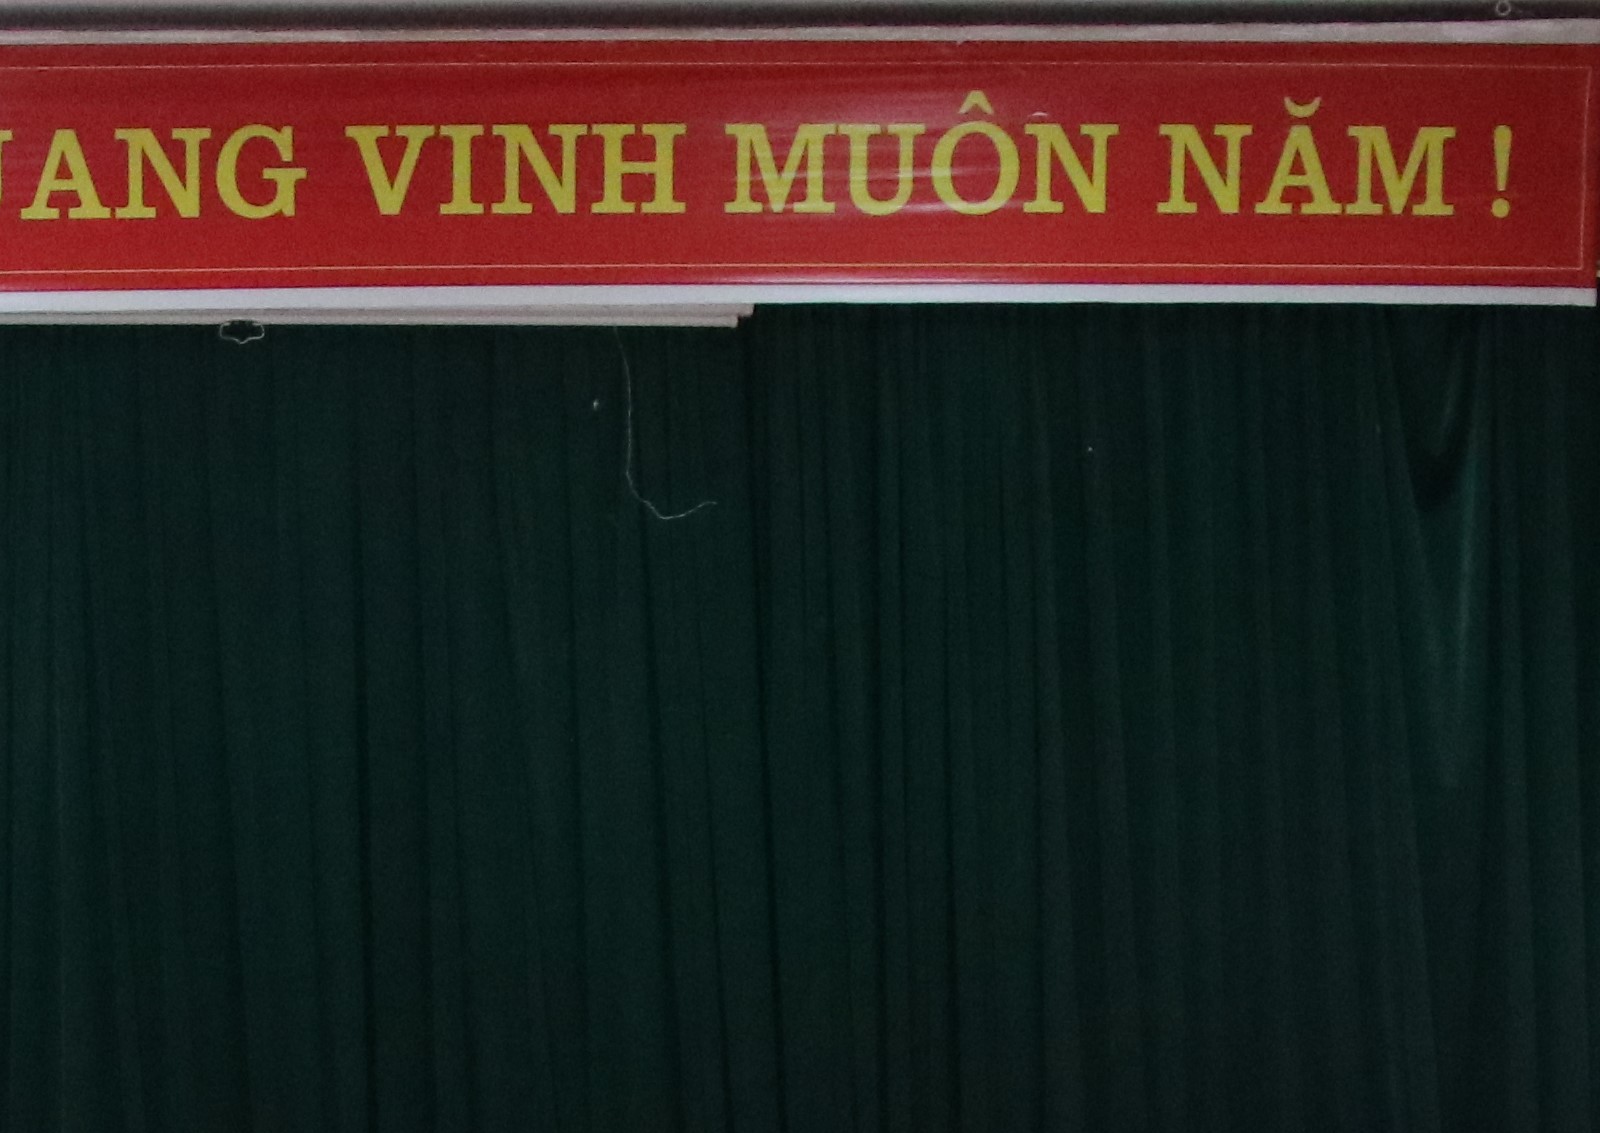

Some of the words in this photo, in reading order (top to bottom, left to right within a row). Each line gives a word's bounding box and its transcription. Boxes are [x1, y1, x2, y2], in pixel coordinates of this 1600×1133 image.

[346, 124, 687, 217] VINH
[724, 90, 1120, 217] MUÔN
[1158, 96, 1457, 217] NĂM
